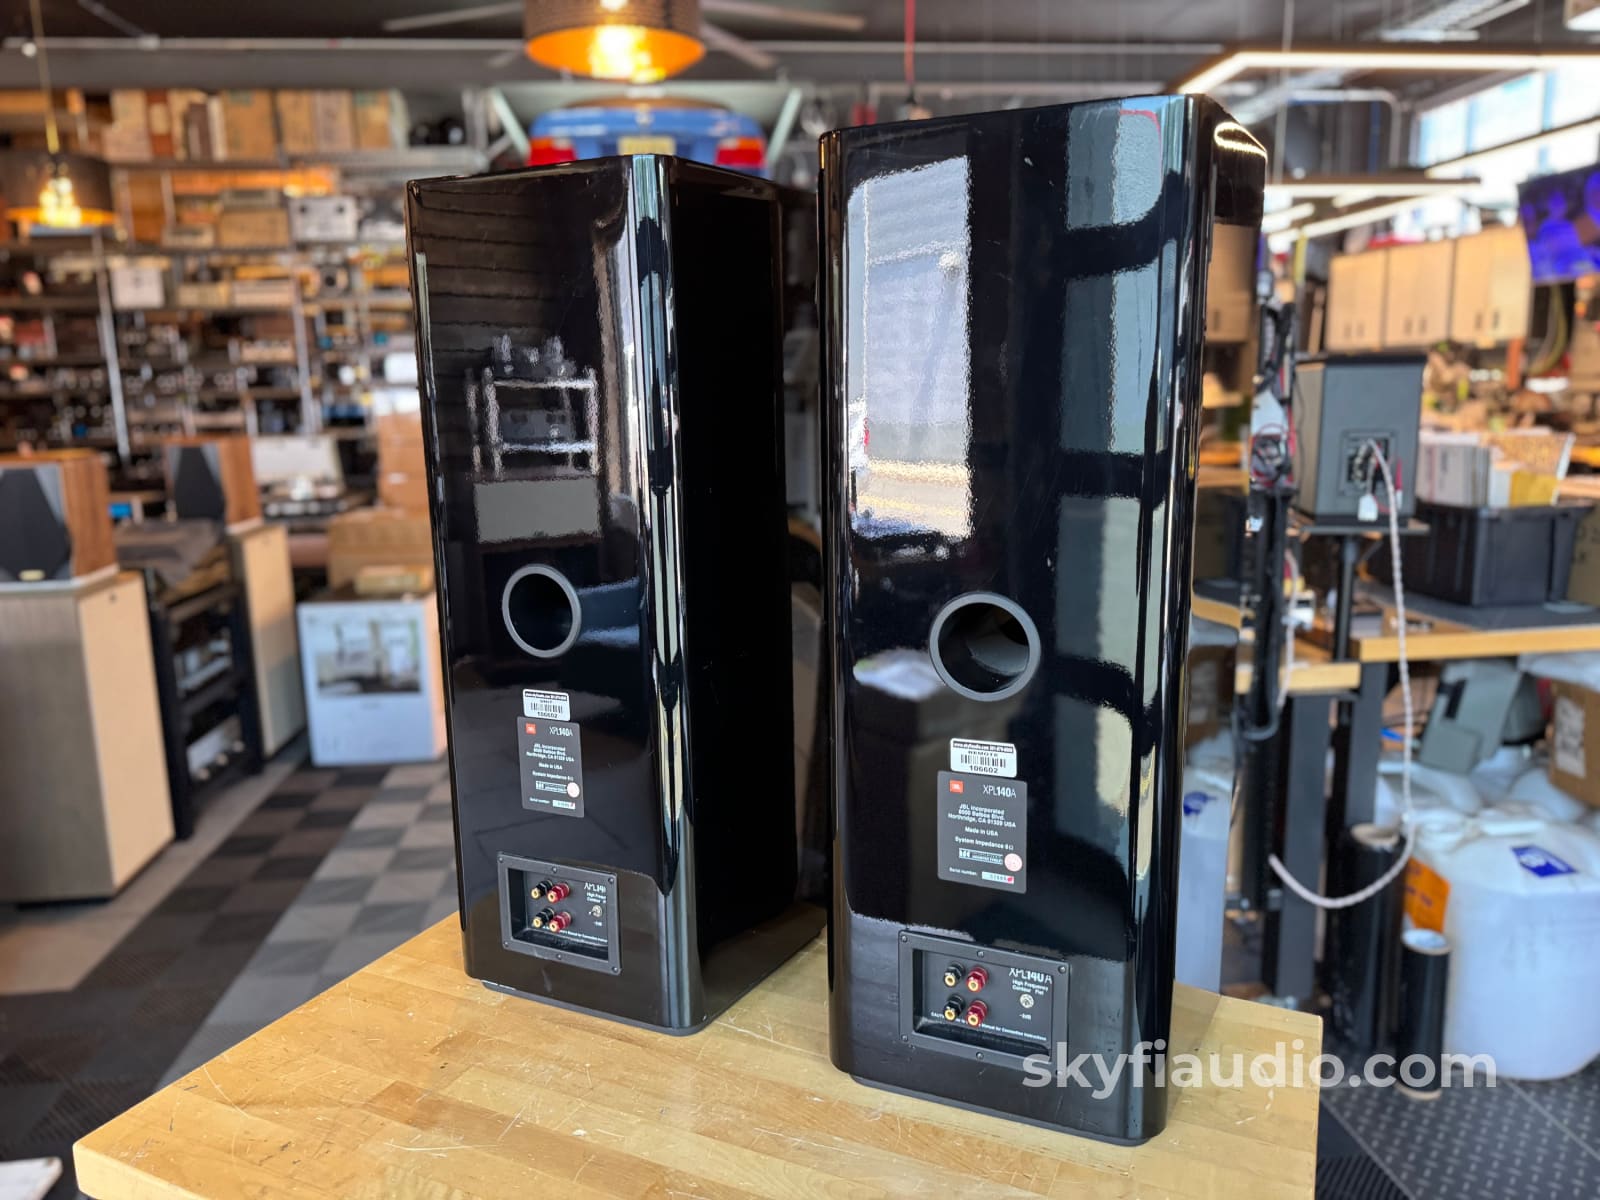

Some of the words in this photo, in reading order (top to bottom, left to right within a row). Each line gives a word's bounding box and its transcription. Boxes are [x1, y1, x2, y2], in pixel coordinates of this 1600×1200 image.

[970, 766, 998, 774] 106602
[982, 784, 1016, 798] XPL140A
[1004, 820, 1016, 828] USA
[964, 826, 979, 834] Made
[954, 835, 974, 844] System
[975, 838, 1004, 849] Impedance
